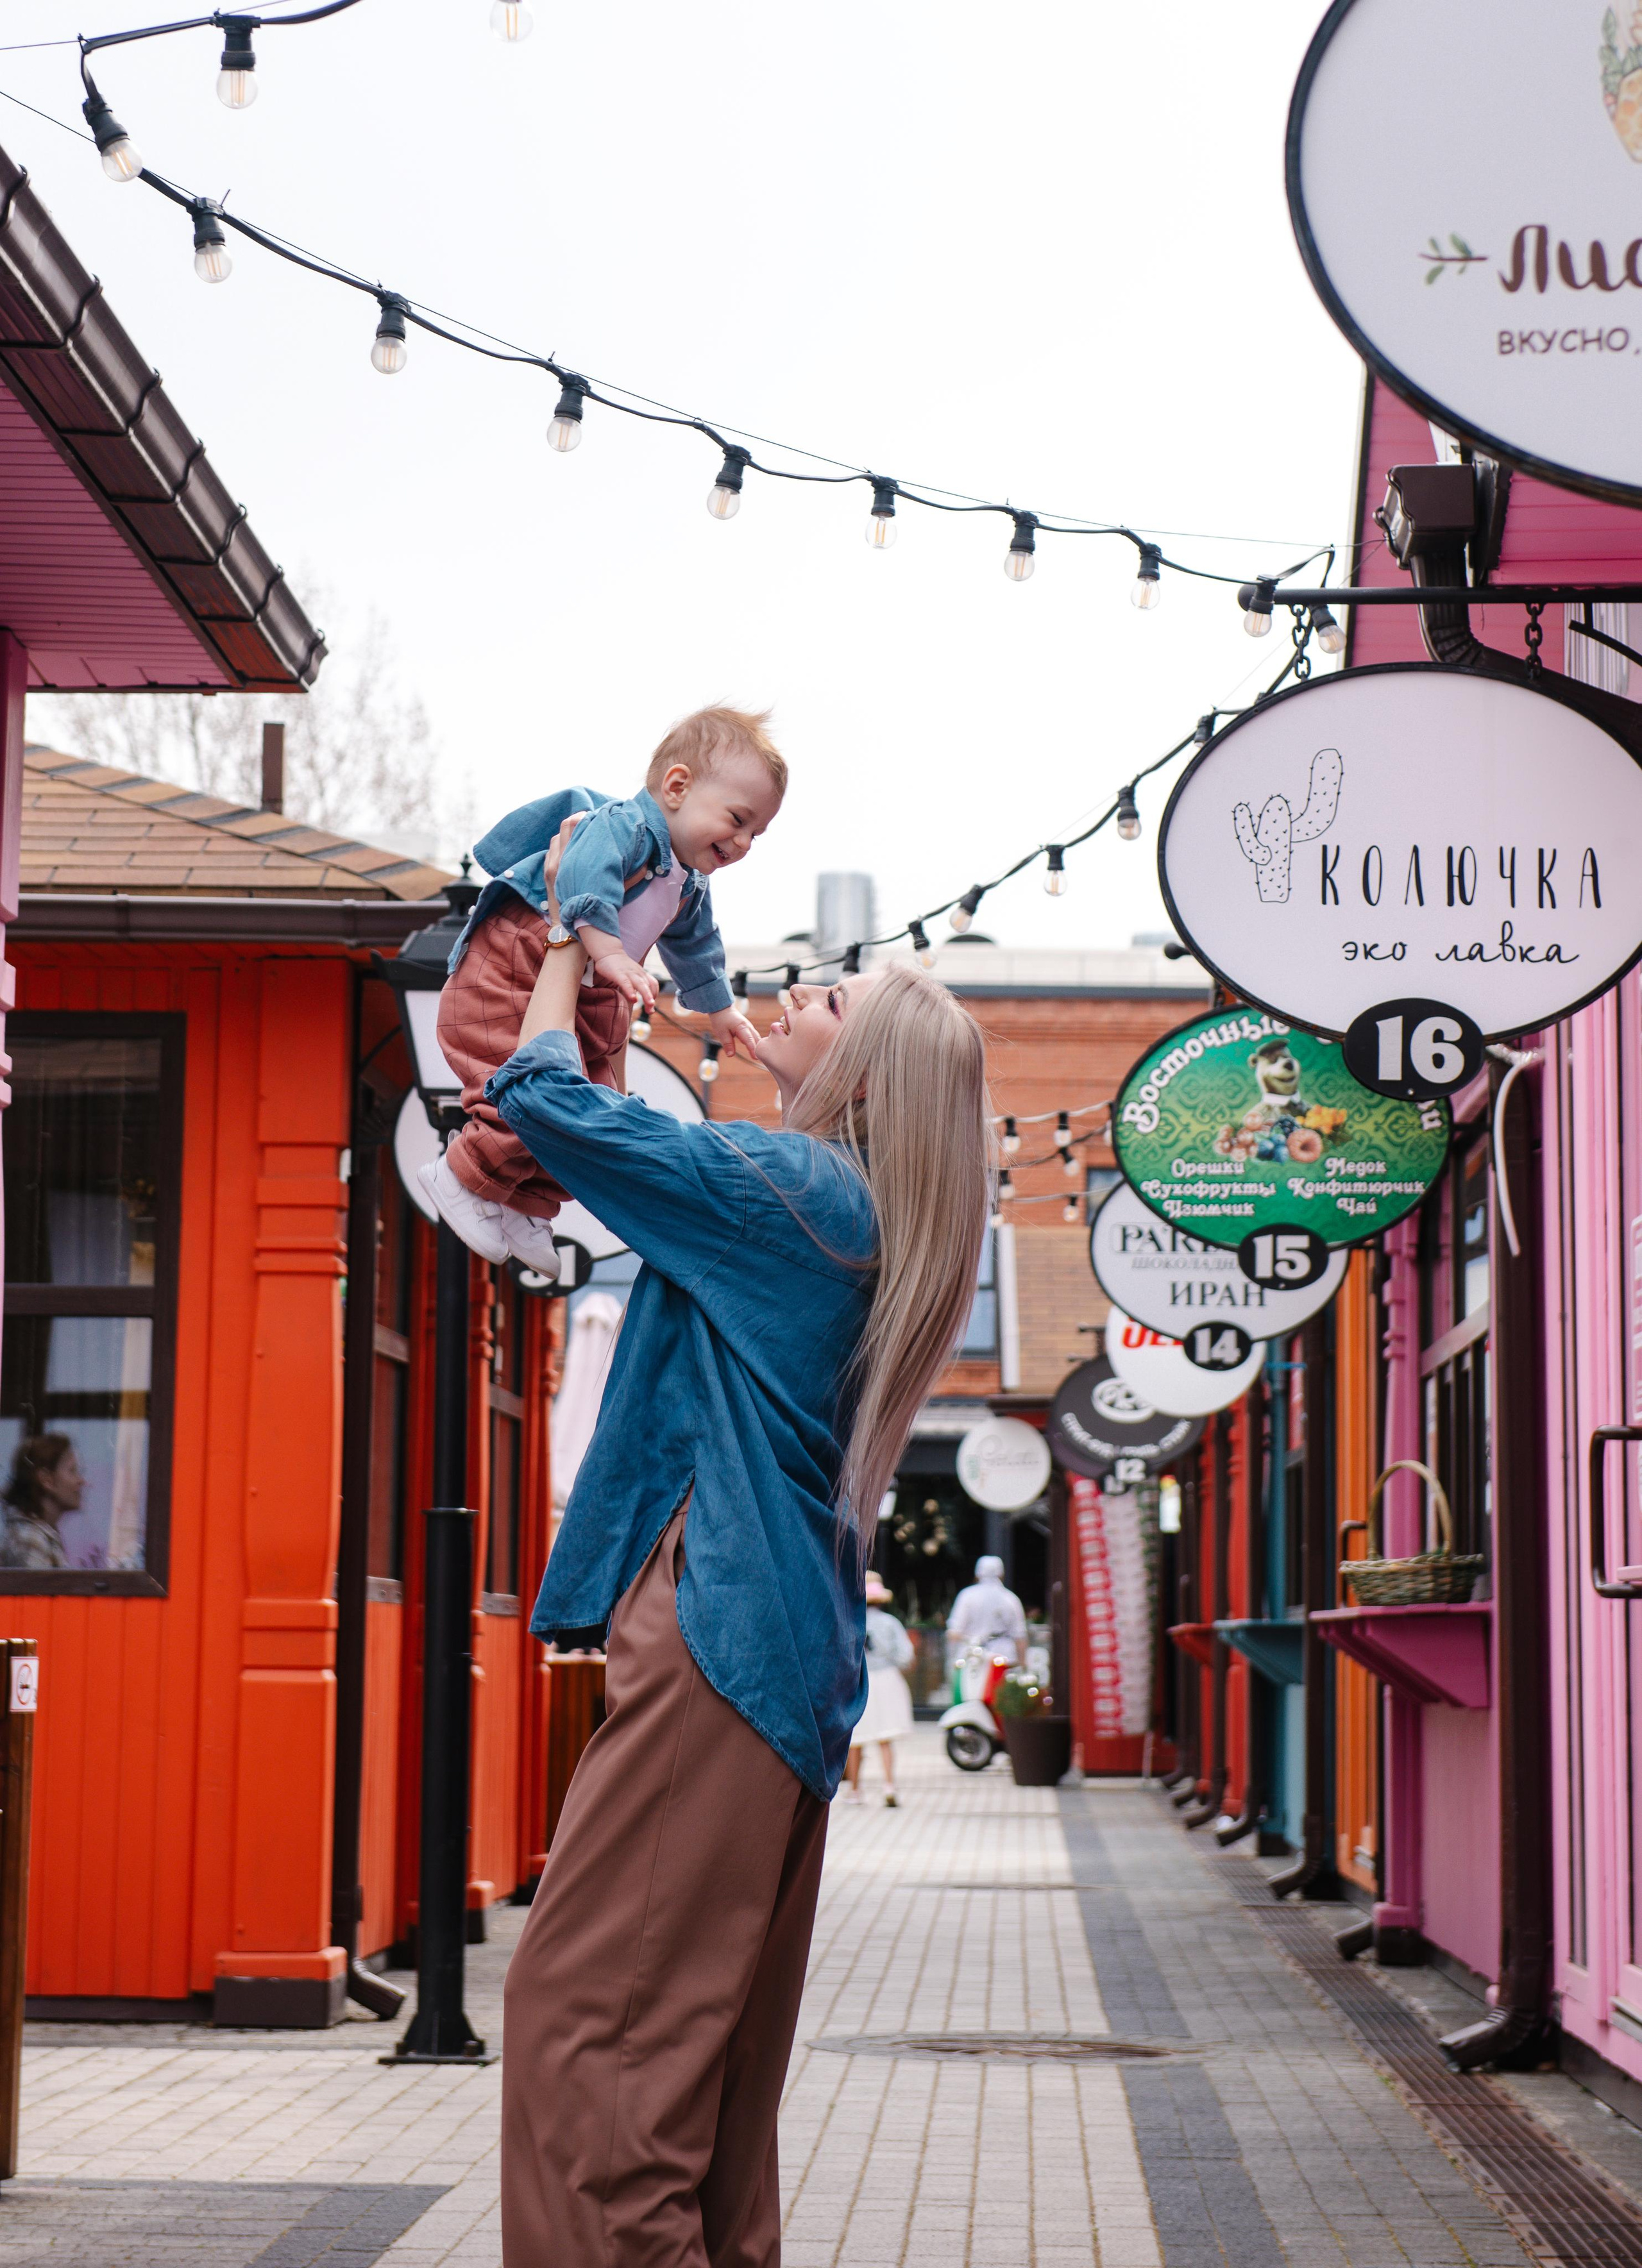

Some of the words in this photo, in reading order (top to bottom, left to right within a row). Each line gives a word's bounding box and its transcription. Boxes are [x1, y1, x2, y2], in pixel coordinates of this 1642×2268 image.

[1321, 844, 1602, 909] КОЛЮЧКА
[1342, 941, 1408, 961] эко
[1435, 920, 1580, 964] лавка
[1375, 1014, 1465, 1084] 16
[1122, 1015, 1291, 1134] Восточные
[1171, 1157, 1246, 1179] Орешки
[1324, 1157, 1387, 1177] Медок
[1140, 1179, 1276, 1199] Сухофрукты
[1286, 1177, 1426, 1199] Конфитюрчик
[1162, 1199, 1255, 1218] Изюмчик
[1335, 1197, 1377, 1216] Чай
[1131, 1255, 1237, 1272] ШОКОЛАДН
[1252, 1233, 1312, 1281] 15
[1169, 1280, 1267, 1307] ИРАН
[1194, 1327, 1242, 1365] 14
[1114, 1458, 1147, 1483] 12
